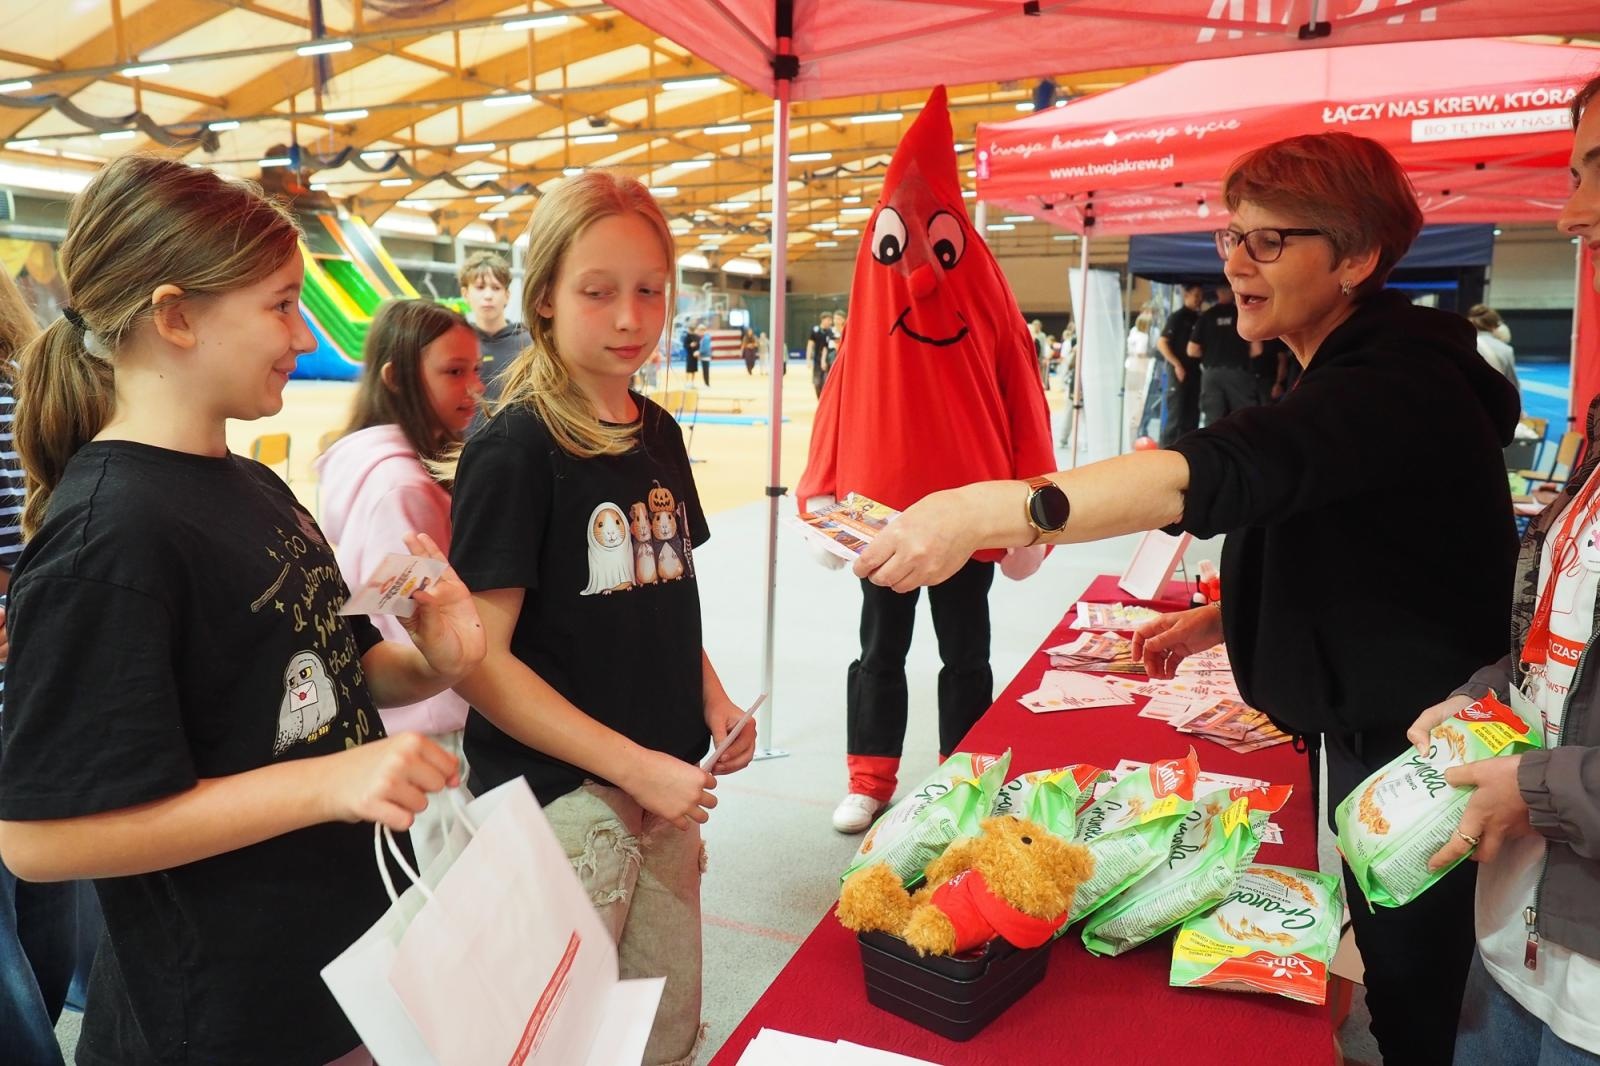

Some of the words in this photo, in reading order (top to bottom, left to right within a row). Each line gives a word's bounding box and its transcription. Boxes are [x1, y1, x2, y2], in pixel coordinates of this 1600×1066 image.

[1322, 103, 1384, 125] ŁĄCZY
[1388, 99, 1430, 119] NAS
[1433, 94, 1499, 115] KREW,
[1504, 87, 1577, 108] KTÓRA
[1500, 118, 1517, 130] W
[1521, 114, 1554, 129] NAS
[1049, 154, 1175, 180] www.twojakrew.pl
[1217, 890, 1317, 930] Granol
